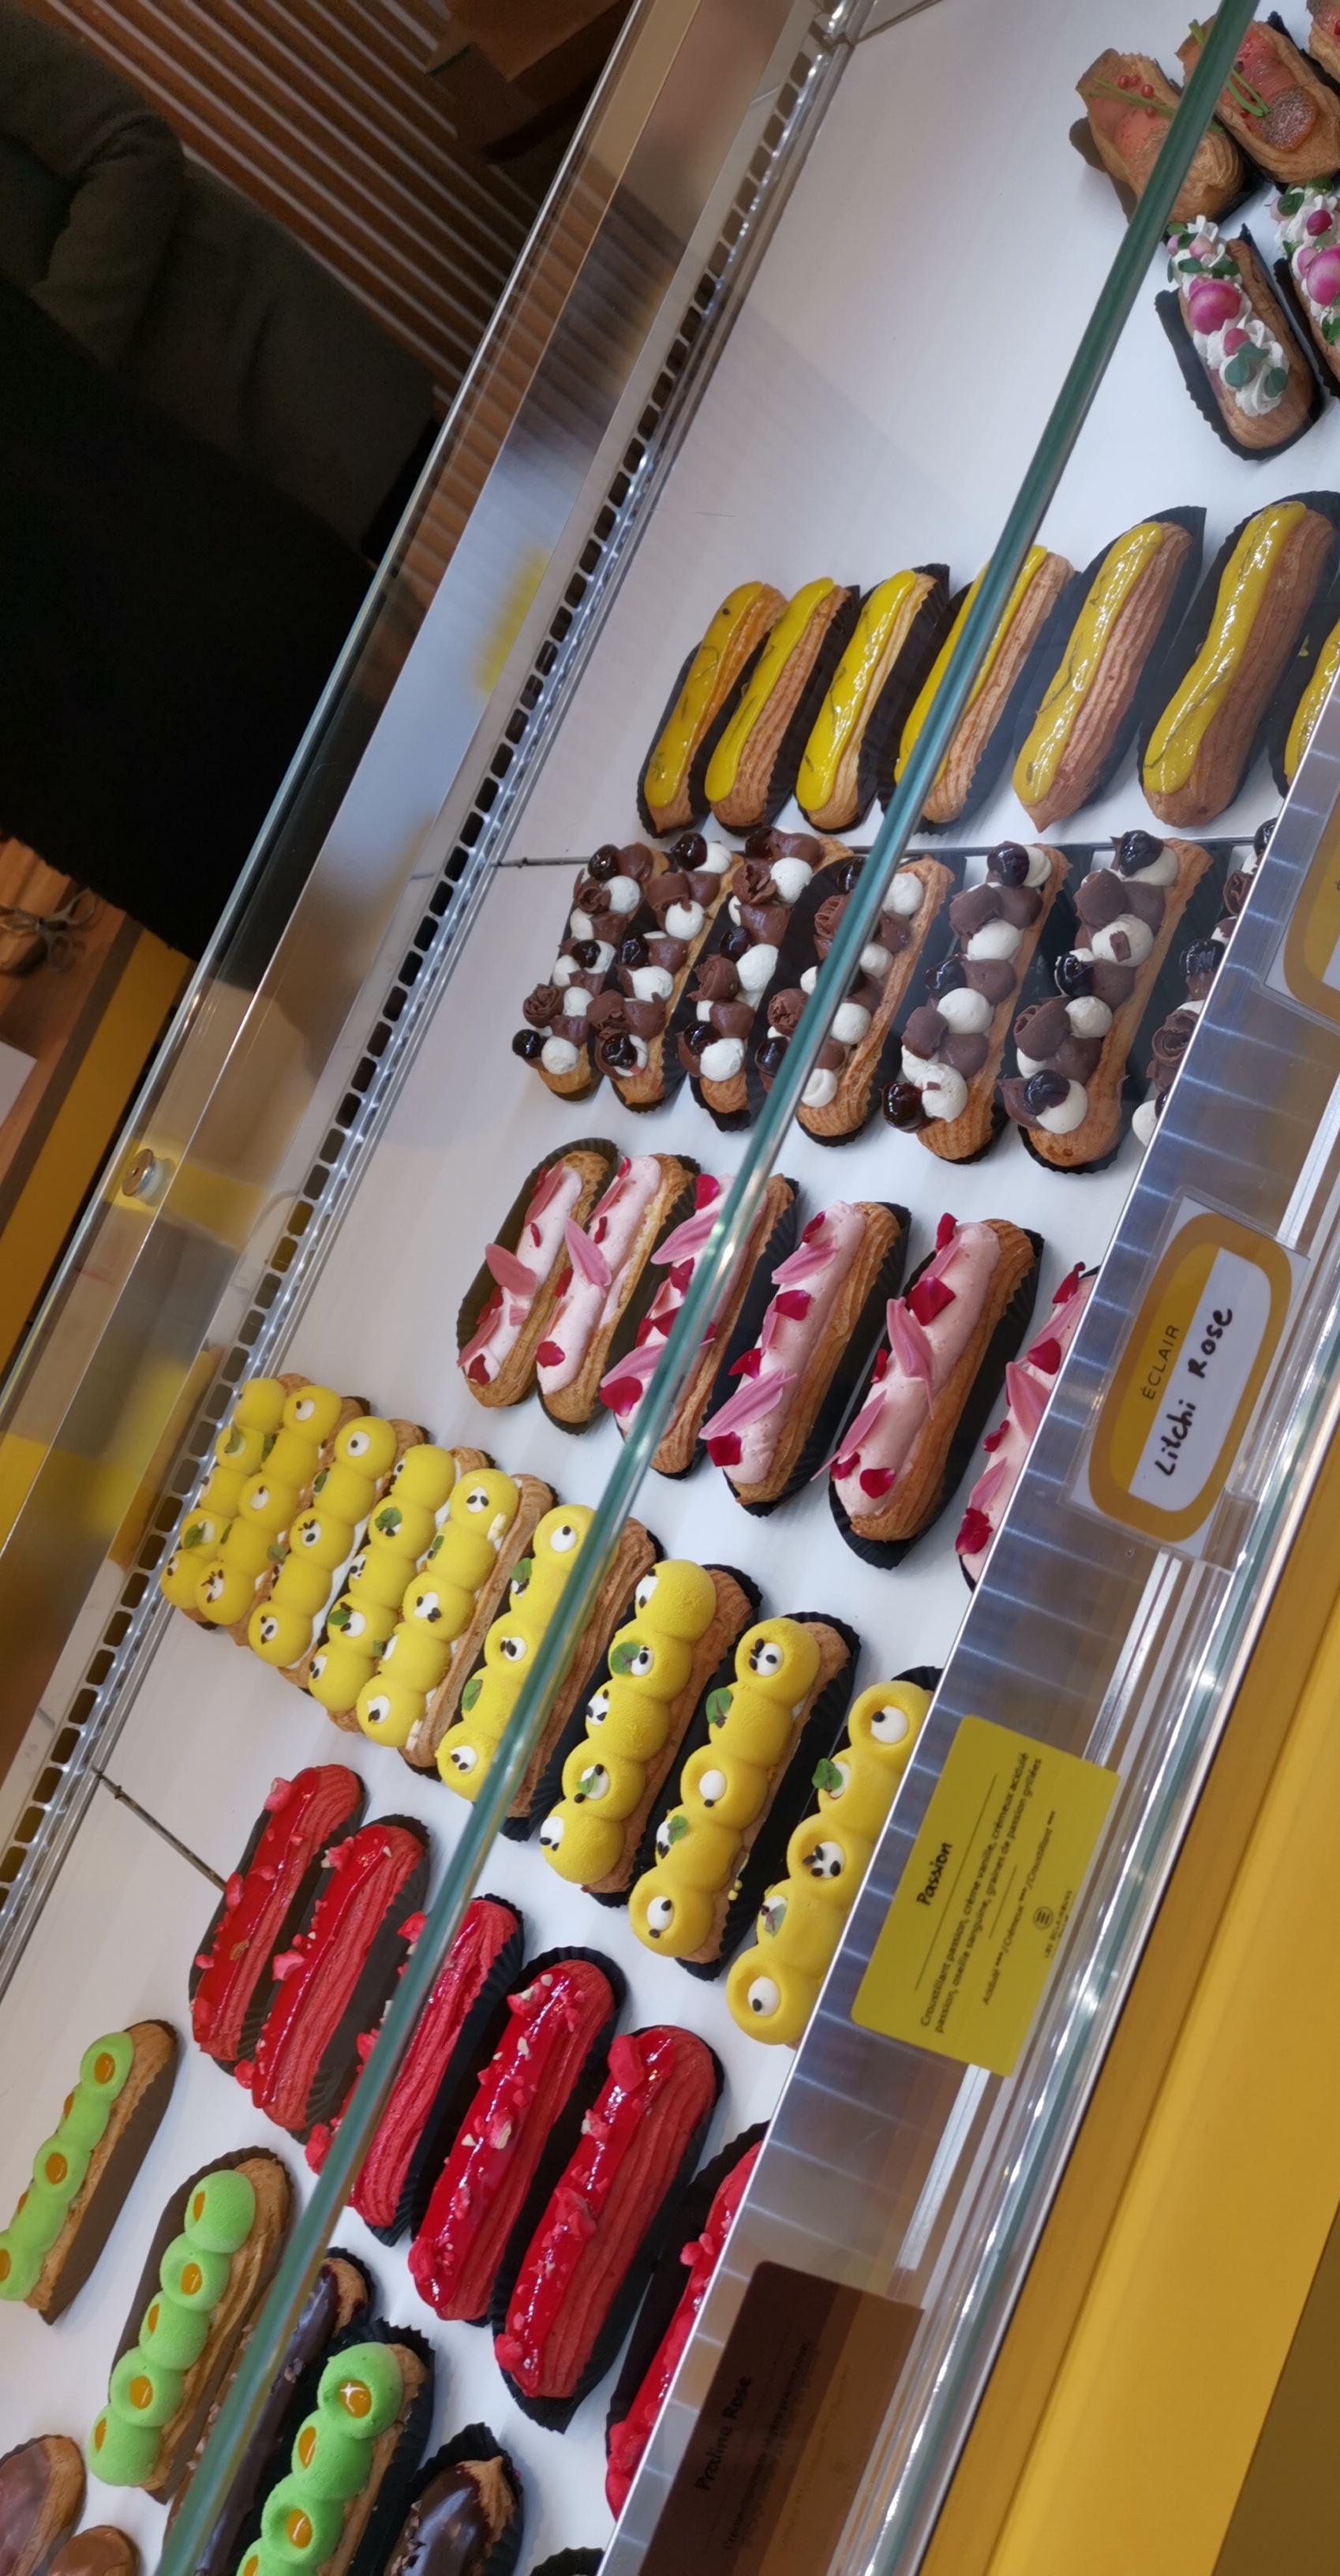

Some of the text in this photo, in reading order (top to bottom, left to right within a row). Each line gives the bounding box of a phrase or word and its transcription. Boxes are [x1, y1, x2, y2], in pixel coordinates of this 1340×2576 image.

[1140, 1324, 1180, 1400] ÉCLAIR
[1155, 1309, 1233, 1476] Litchi Rose
[916, 1842, 953, 1906] Passion
[934, 1989, 959, 2034] passion,
[953, 1950, 971, 1986] oseille
[1001, 1840, 1011, 1855] de
[1006, 1798, 1027, 1840] passion
[920, 1962, 951, 2027] Croustillant
[946, 1919, 970, 1962] passion,
